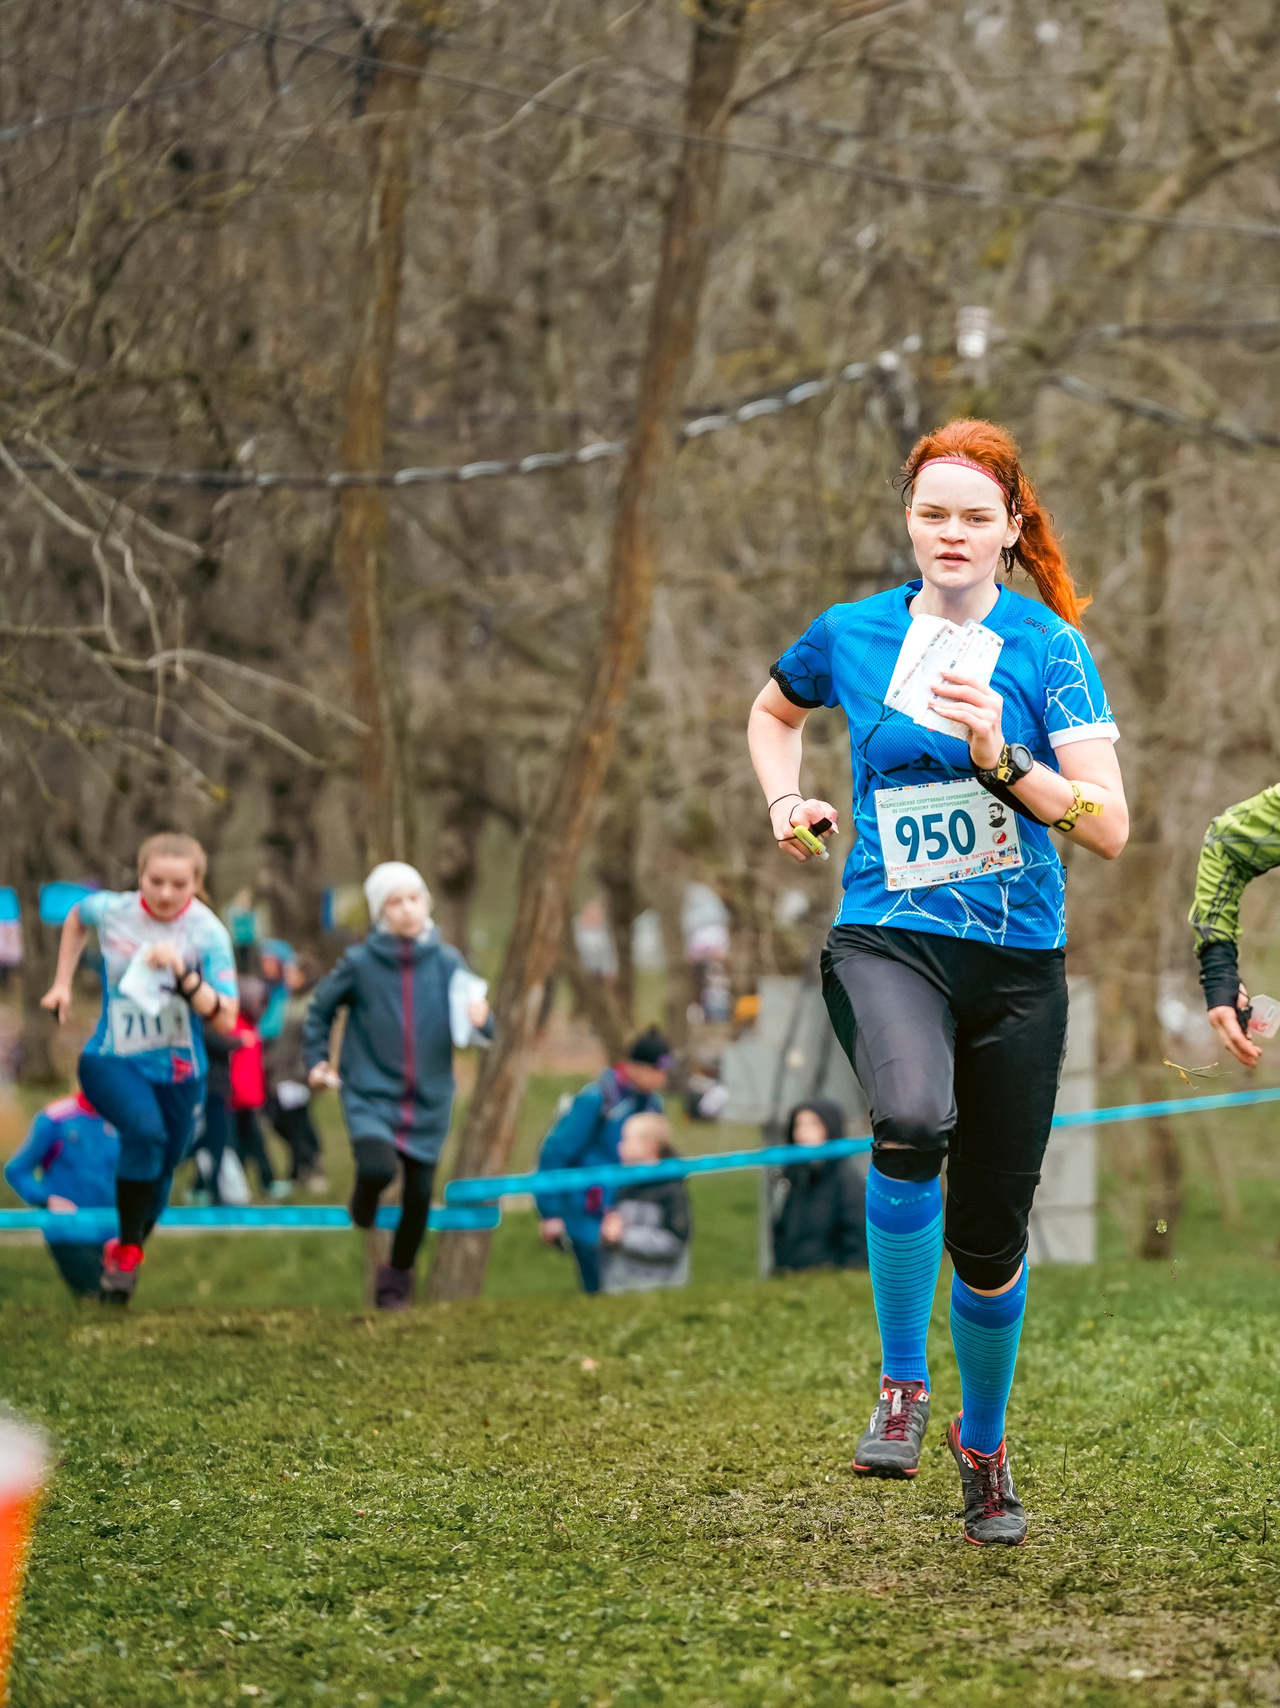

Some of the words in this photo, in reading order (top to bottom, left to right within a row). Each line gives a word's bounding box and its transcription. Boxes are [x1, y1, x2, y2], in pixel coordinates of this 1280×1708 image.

[961, 459, 983, 470] STOP
[916, 796, 945, 804] СПОРТИВНЫЕ
[945, 791, 979, 800] СОРЕВНОВАНИЯ
[899, 803, 929, 813] СПОРТИВНОМУ
[895, 809, 976, 863] 950
